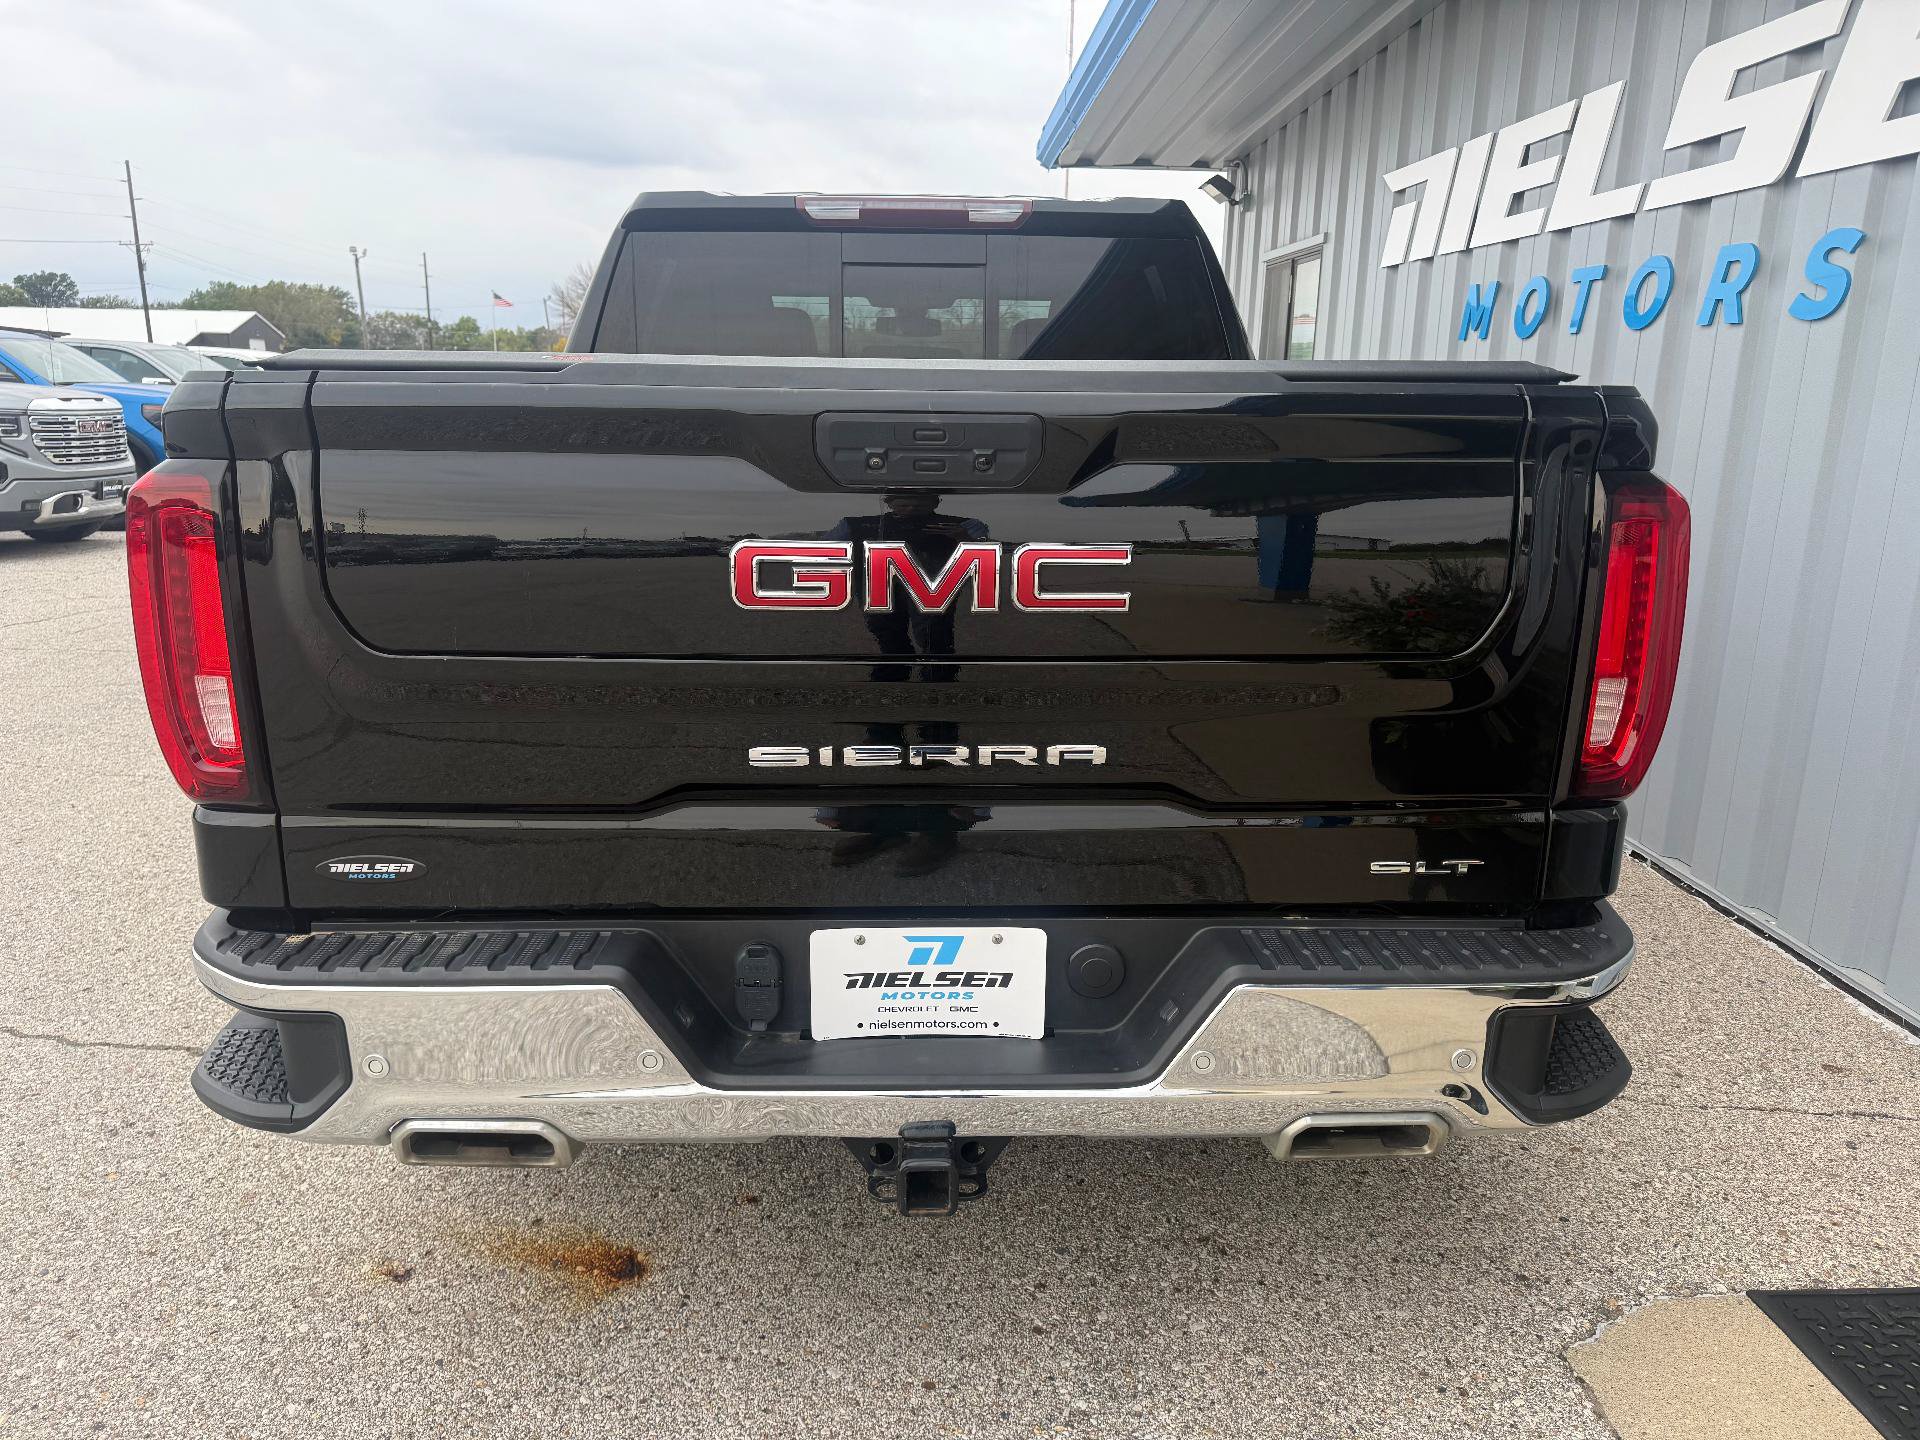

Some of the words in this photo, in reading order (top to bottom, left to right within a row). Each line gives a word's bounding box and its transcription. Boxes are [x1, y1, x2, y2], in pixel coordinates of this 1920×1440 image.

[1458, 227, 1867, 341] MOTORS
[729, 538, 1134, 613] GMC
[748, 744, 1107, 767] SIERRA
[328, 863, 415, 873] NIELSEN
[1369, 860, 1485, 876] SLT
[843, 971, 1014, 989] NIELSEN
[880, 991, 975, 1001] MOTORS
[877, 1005, 939, 1013] CHEVROLET
[949, 1005, 979, 1013] GMC
[868, 1017, 988, 1030] nielsenmotors.com
